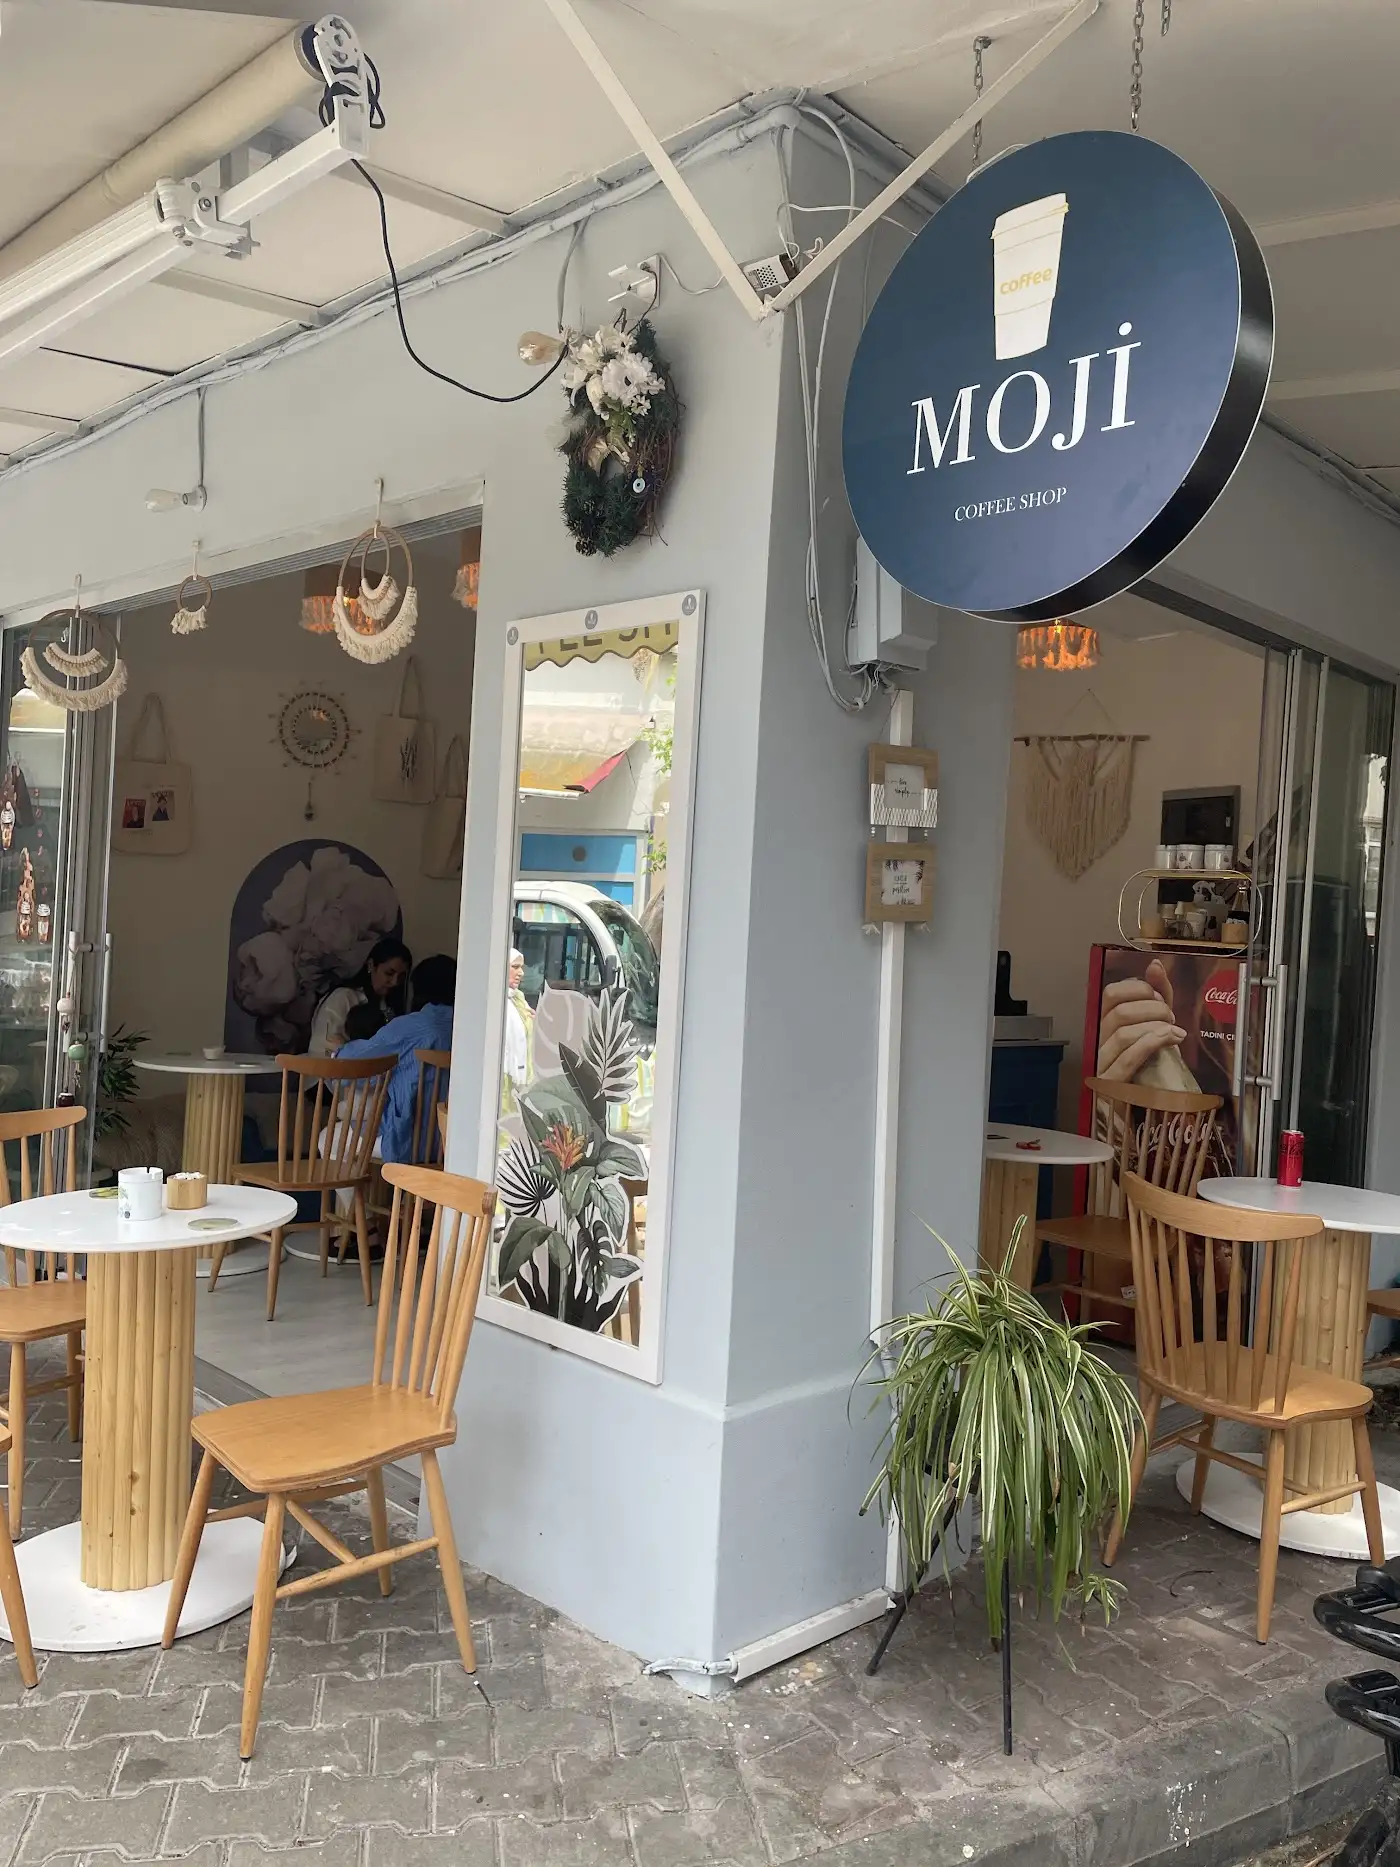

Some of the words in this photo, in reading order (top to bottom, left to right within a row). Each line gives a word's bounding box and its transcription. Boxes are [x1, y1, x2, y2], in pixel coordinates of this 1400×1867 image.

[1000, 268, 1052, 295] coffee
[906, 322, 1141, 475] MOJİ
[954, 496, 1016, 521] COFFEE
[1019, 487, 1067, 510] SHOP
[1200, 1030, 1225, 1040] TADINI
